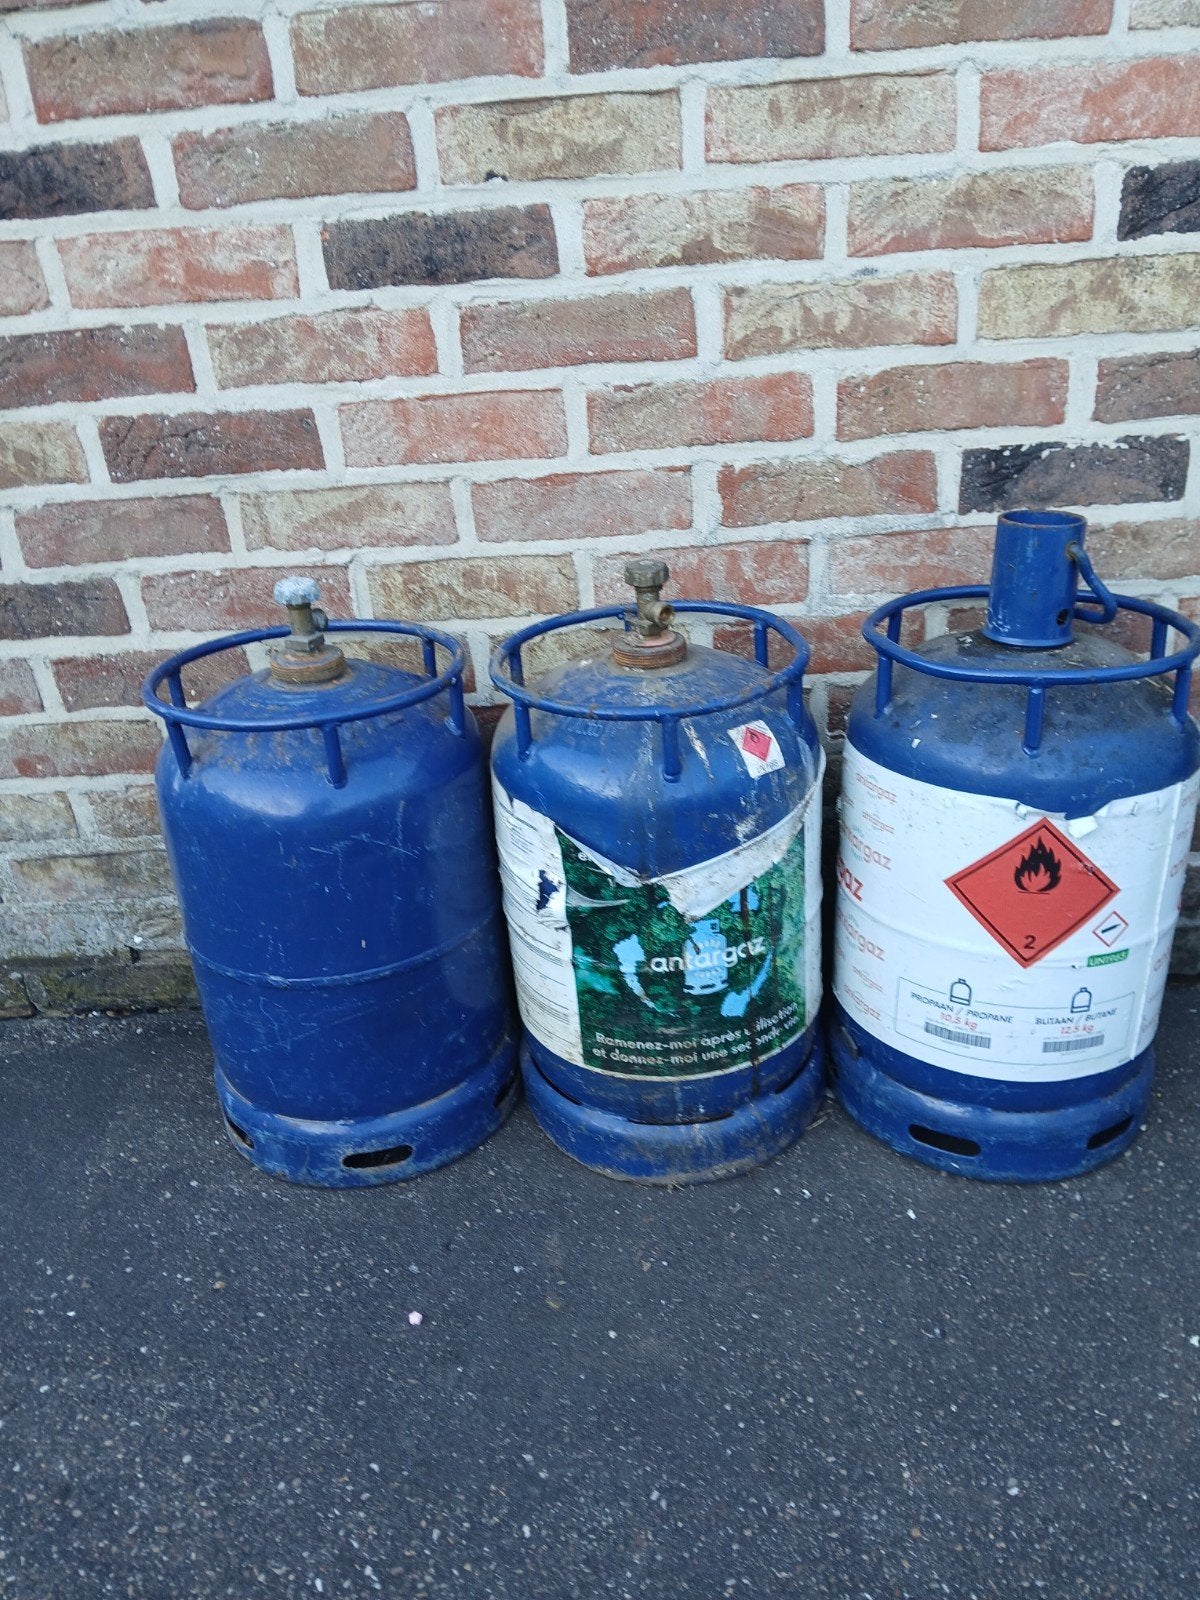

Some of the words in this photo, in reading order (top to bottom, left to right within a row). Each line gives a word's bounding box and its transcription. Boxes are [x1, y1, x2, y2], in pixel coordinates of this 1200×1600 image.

[1023, 934, 1037, 949] 2
[911, 991, 954, 1013] PROPAAN
[966, 1008, 1014, 1024] PROPANE
[1034, 1016, 1075, 1026] BUTAAN
